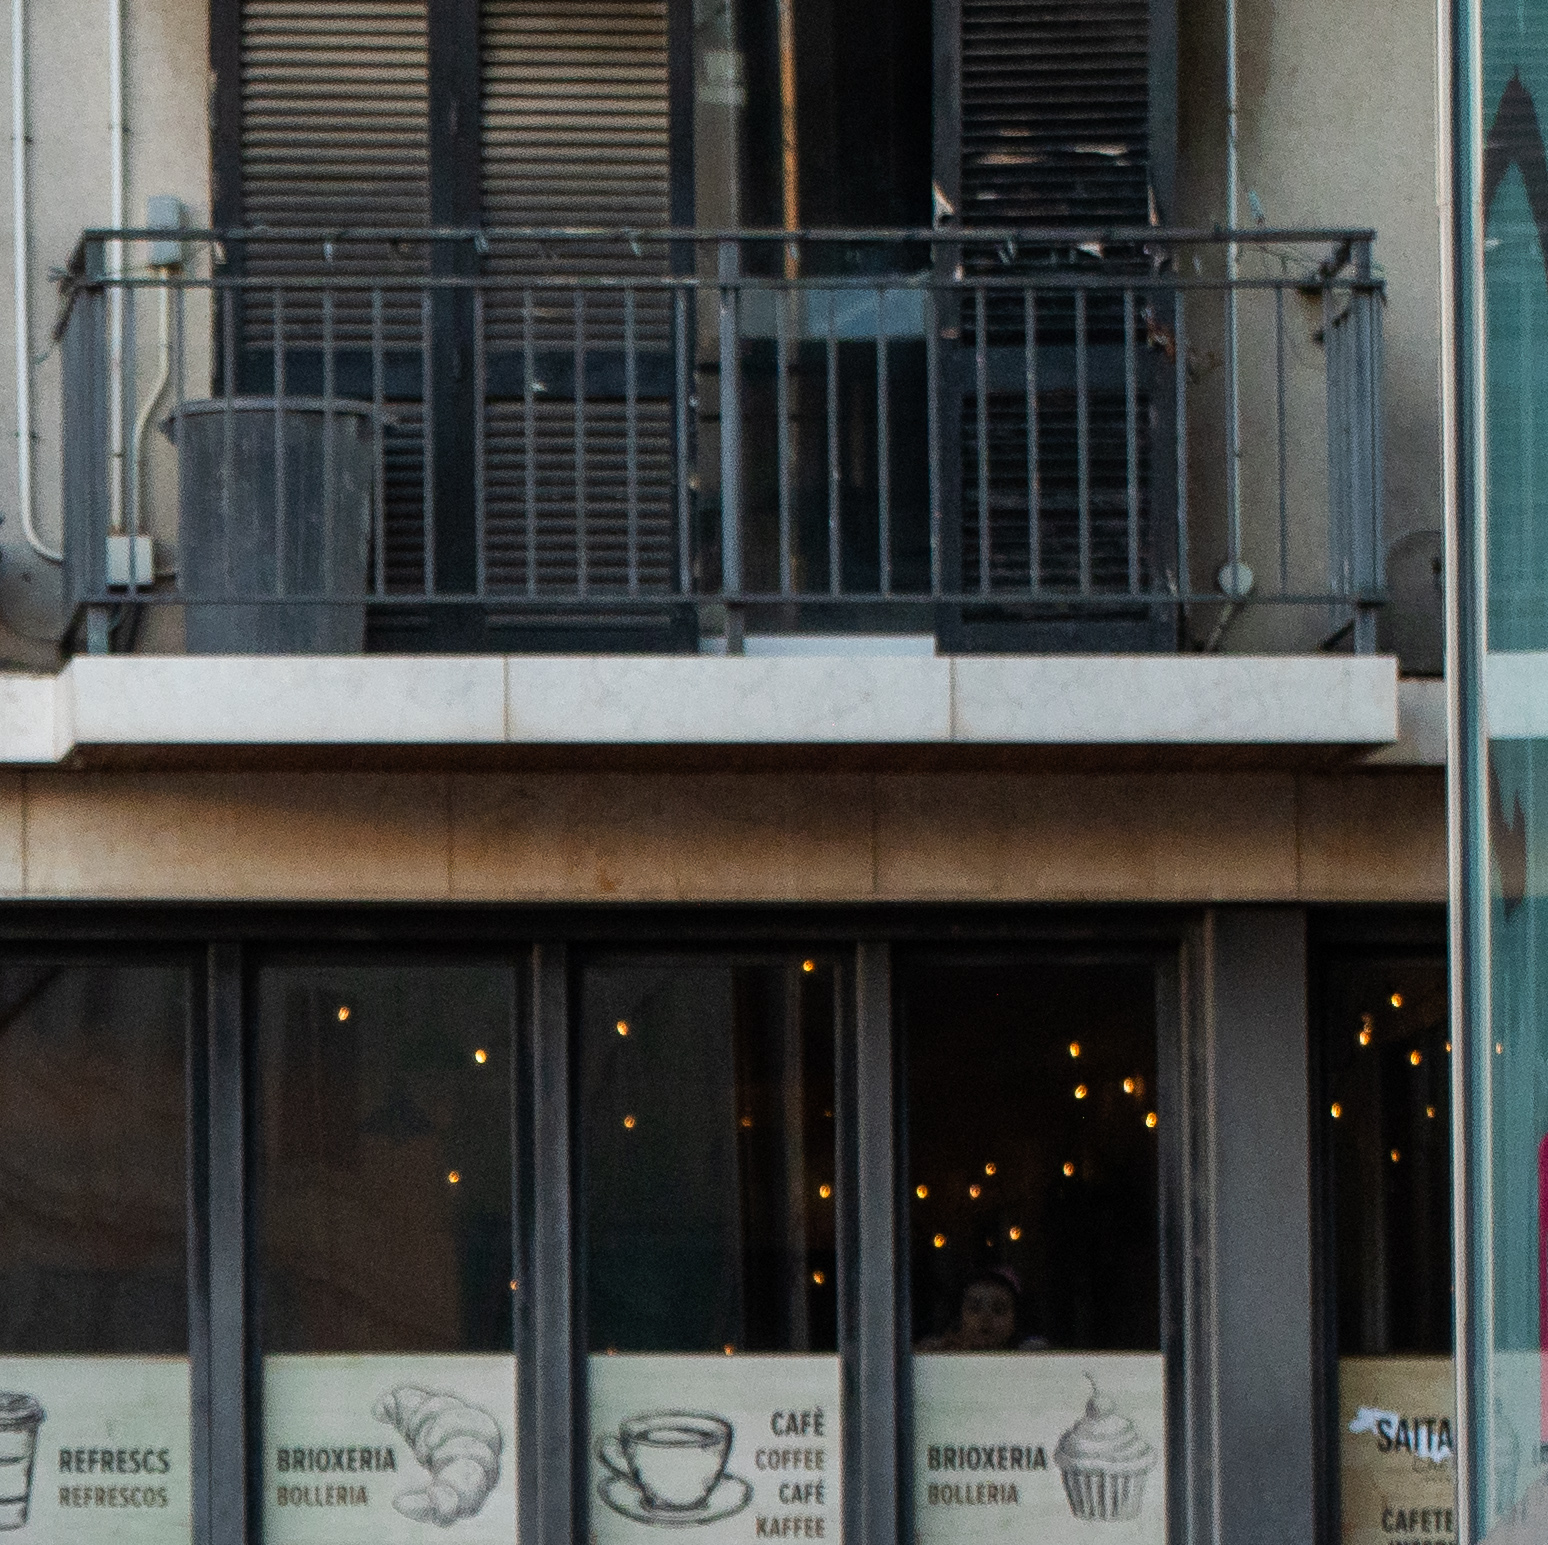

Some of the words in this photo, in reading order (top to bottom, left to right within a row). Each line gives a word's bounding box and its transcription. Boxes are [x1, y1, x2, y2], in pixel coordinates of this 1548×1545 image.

[58, 1446, 170, 1475] REFRESCS
[276, 1446, 397, 1474] BRIOXERIA
[755, 1447, 826, 1471] COFFEE
[927, 1444, 1048, 1472] BRIOXERIA
[58, 1483, 169, 1509] REFRESCOS
[276, 1484, 370, 1508] BOLLERIA
[927, 1482, 1020, 1507] BOLLERIA
[756, 1514, 826, 1540] KAFFEE
